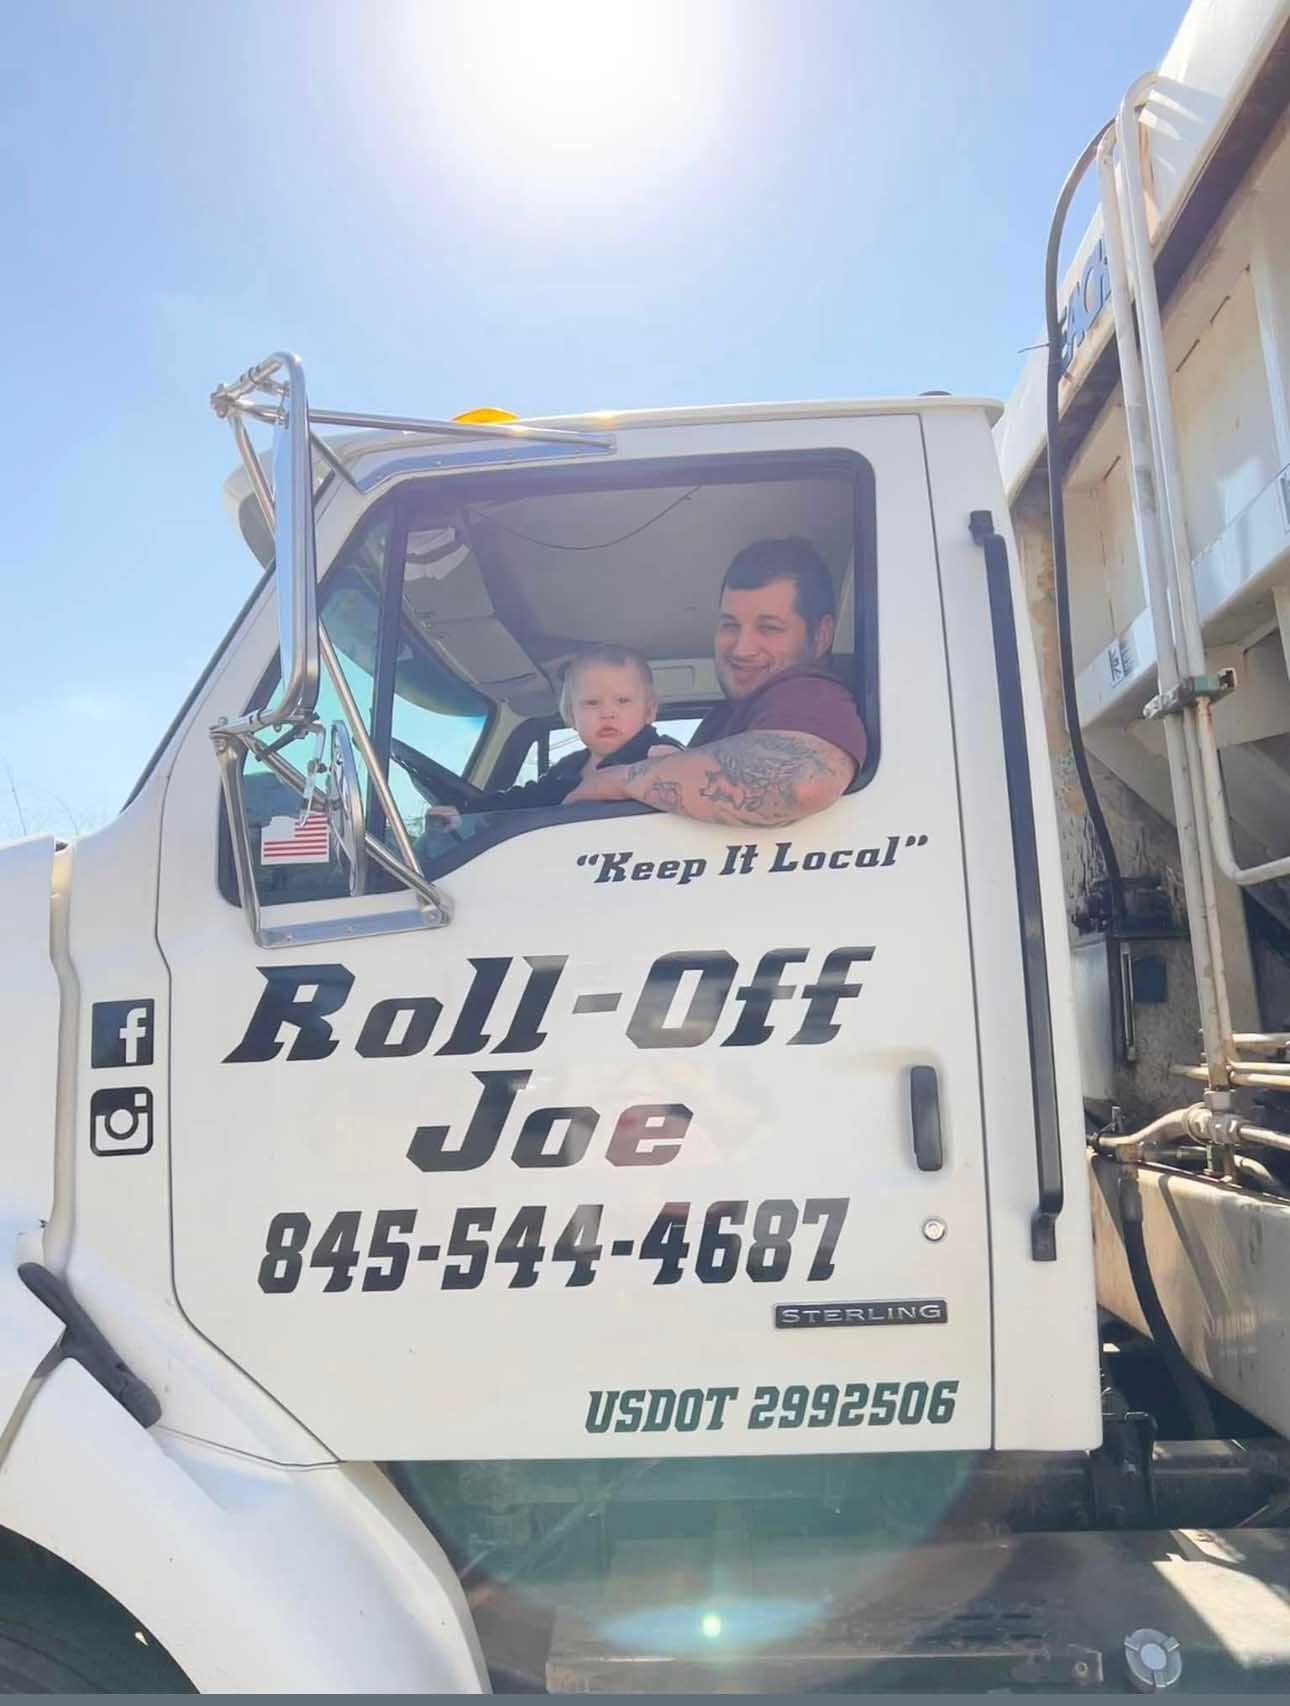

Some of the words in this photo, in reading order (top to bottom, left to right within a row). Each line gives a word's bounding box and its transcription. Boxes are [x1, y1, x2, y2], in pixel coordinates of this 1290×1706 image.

[719, 844, 759, 876] It
[221, 946, 875, 1063] Roll-Off
[406, 1069, 693, 1172] Joe
[257, 1197, 850, 1293] 845-544-4687
[781, 1304, 943, 1324] STERLING
[585, 1387, 739, 1433] USDOT
[748, 1380, 960, 1429] 2992506
